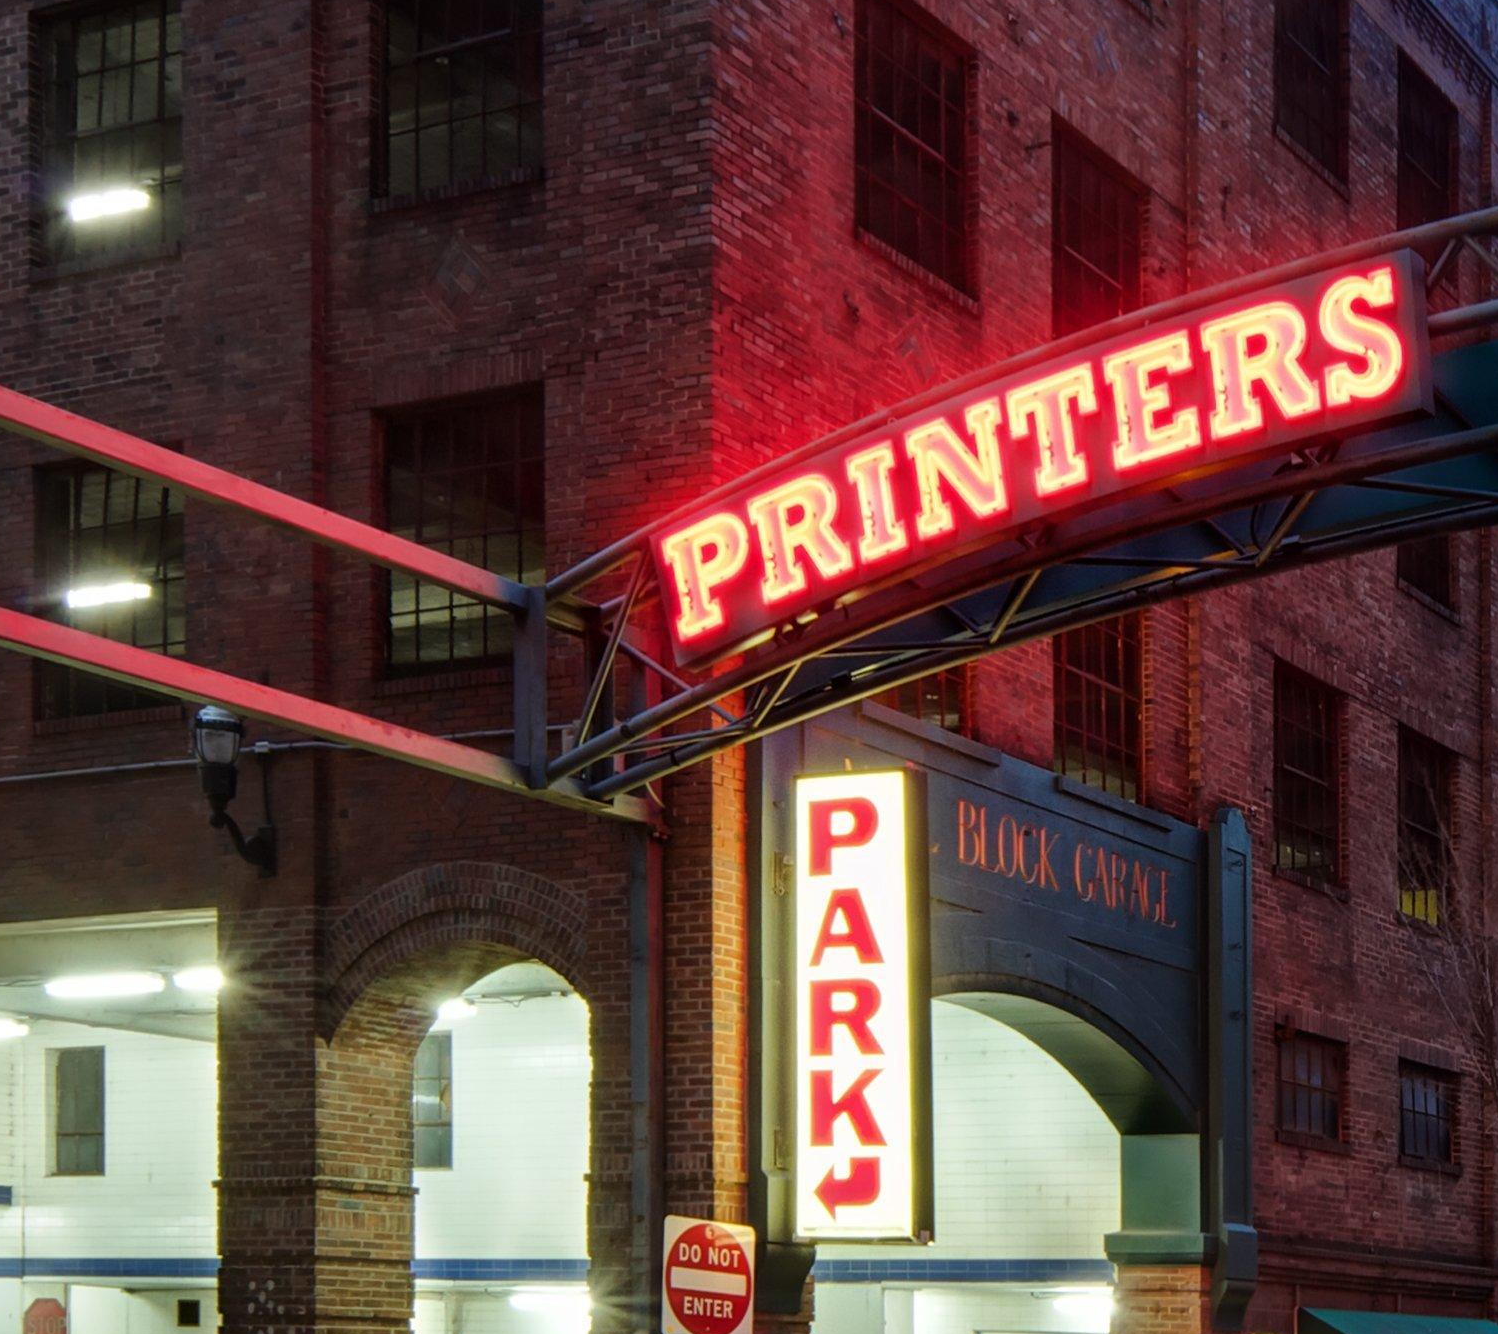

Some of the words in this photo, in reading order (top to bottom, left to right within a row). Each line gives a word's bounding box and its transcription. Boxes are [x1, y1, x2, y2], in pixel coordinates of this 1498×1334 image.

[658, 267, 1406, 645] PRINTERS
[958, 799, 1062, 893] BLOCK
[1074, 841, 1177, 929] GARAGE
[807, 796, 888, 1147] PARK
[678, 1242, 702, 1264] DO
[707, 1246, 741, 1268] NOT
[683, 1295, 734, 1319] ENTER
